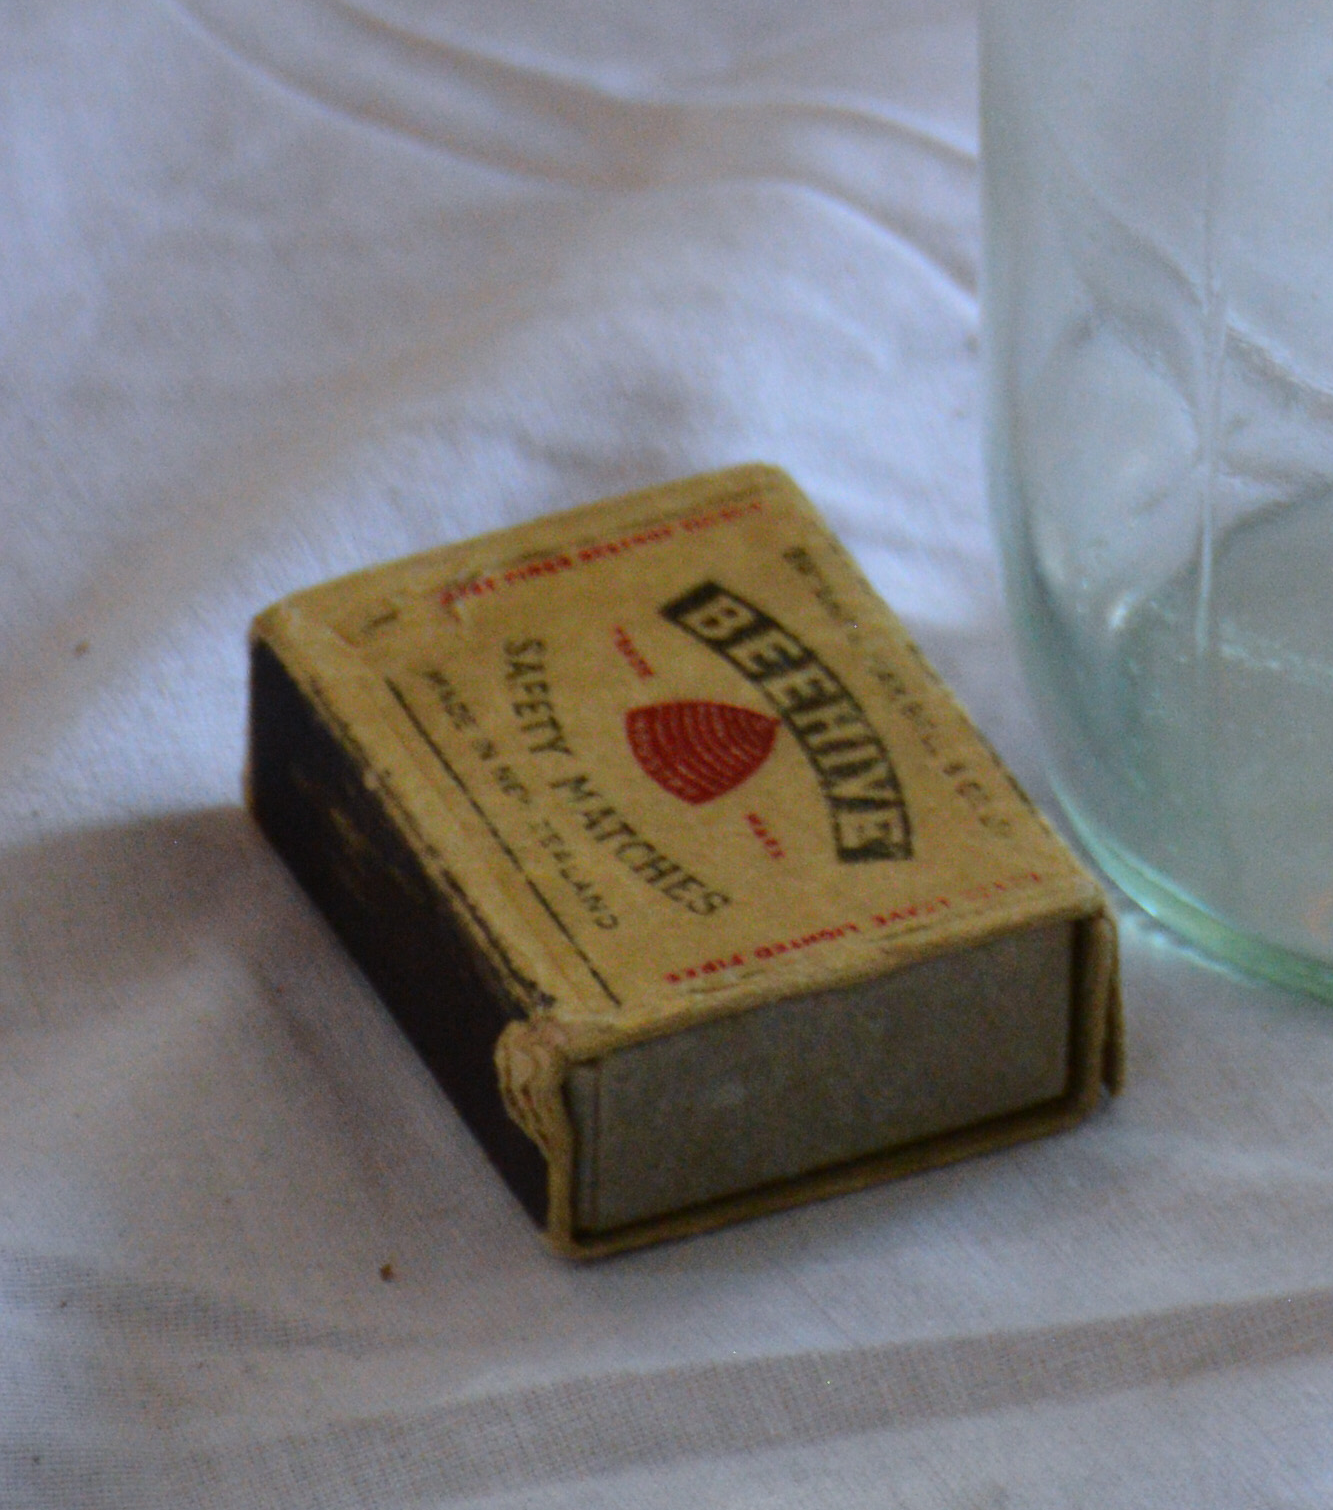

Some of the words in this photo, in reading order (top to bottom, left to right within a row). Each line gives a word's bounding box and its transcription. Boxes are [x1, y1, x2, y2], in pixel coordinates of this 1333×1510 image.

[502, 635, 574, 756] SAFETY
[550, 773, 733, 919] MATCHES
[676, 586, 906, 851] BEEHIVE
